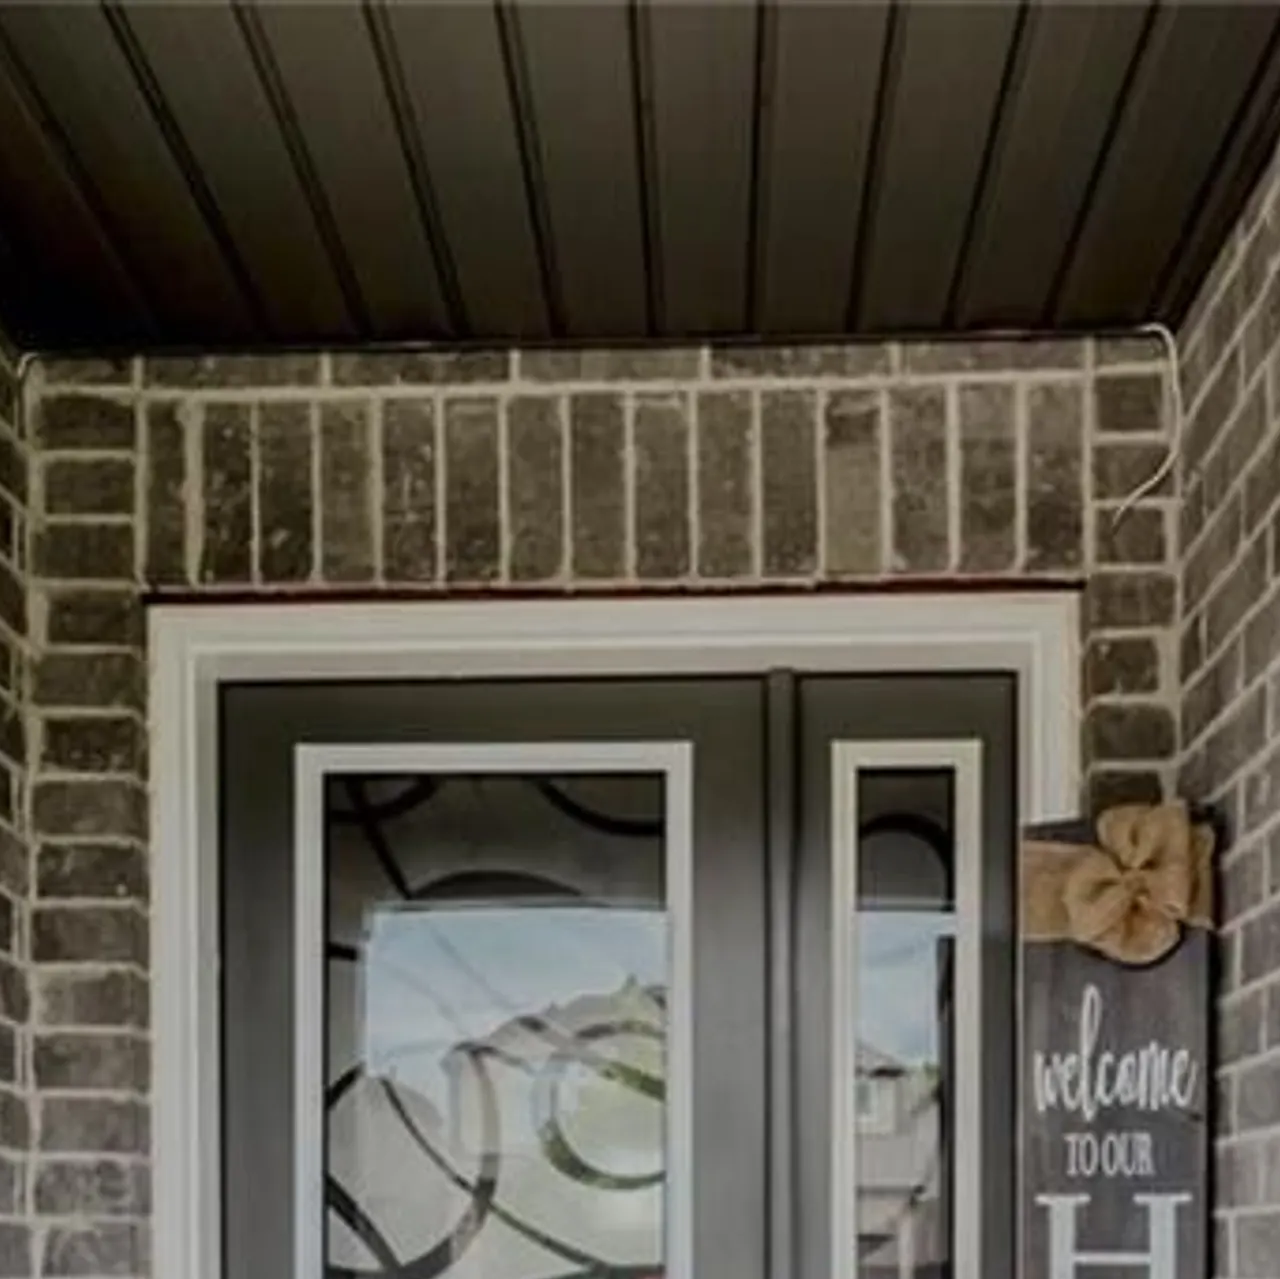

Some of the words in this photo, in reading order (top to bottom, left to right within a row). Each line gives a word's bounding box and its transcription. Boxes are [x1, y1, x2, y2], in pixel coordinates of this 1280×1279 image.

[1033, 985, 1198, 1122] welcome
[1063, 1131, 1099, 1177] TO
[1100, 1131, 1157, 1177] OUR
